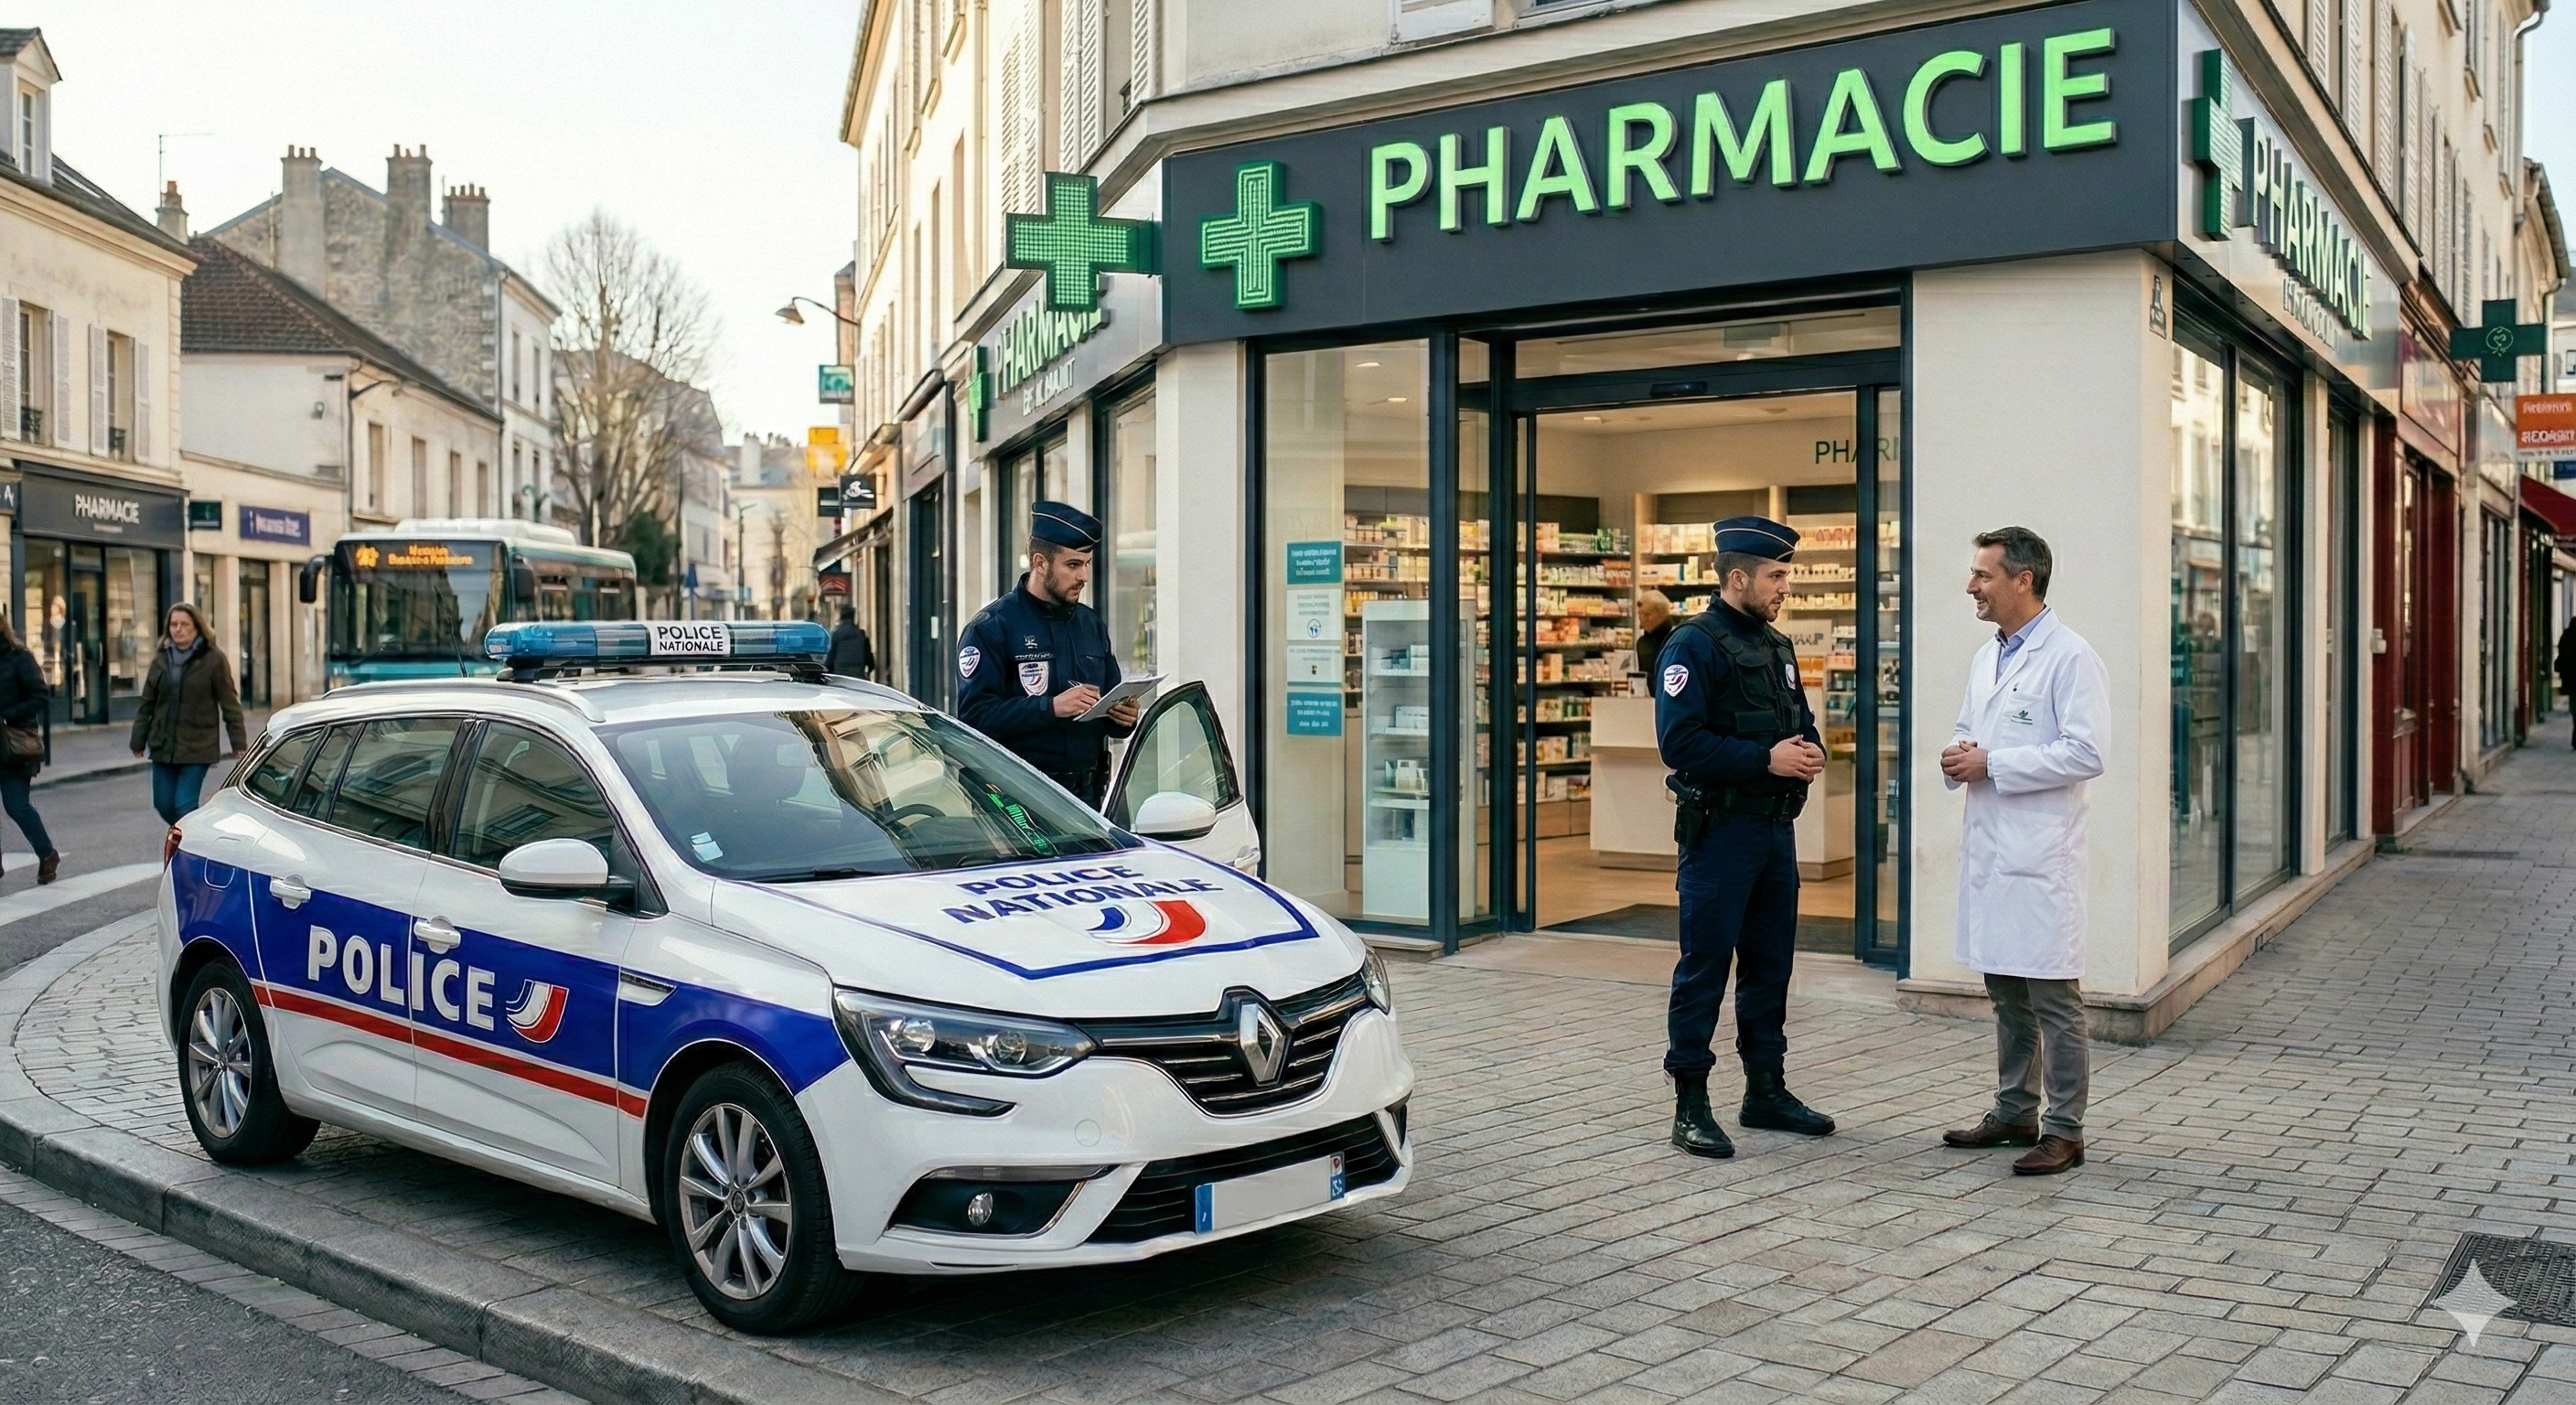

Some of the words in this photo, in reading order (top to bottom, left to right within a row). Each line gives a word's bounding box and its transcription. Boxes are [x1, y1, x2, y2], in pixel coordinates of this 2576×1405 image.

[1369, 27, 2117, 242] PHARMACIE
[2252, 116, 2373, 342] PHARMACIE
[657, 626, 723, 639] POLICE
[659, 640, 724, 652] NATIONALE
[940, 877, 1224, 925] NATIONALE
[955, 864, 1144, 896] POLICE
[306, 924, 496, 1032] POLICE
